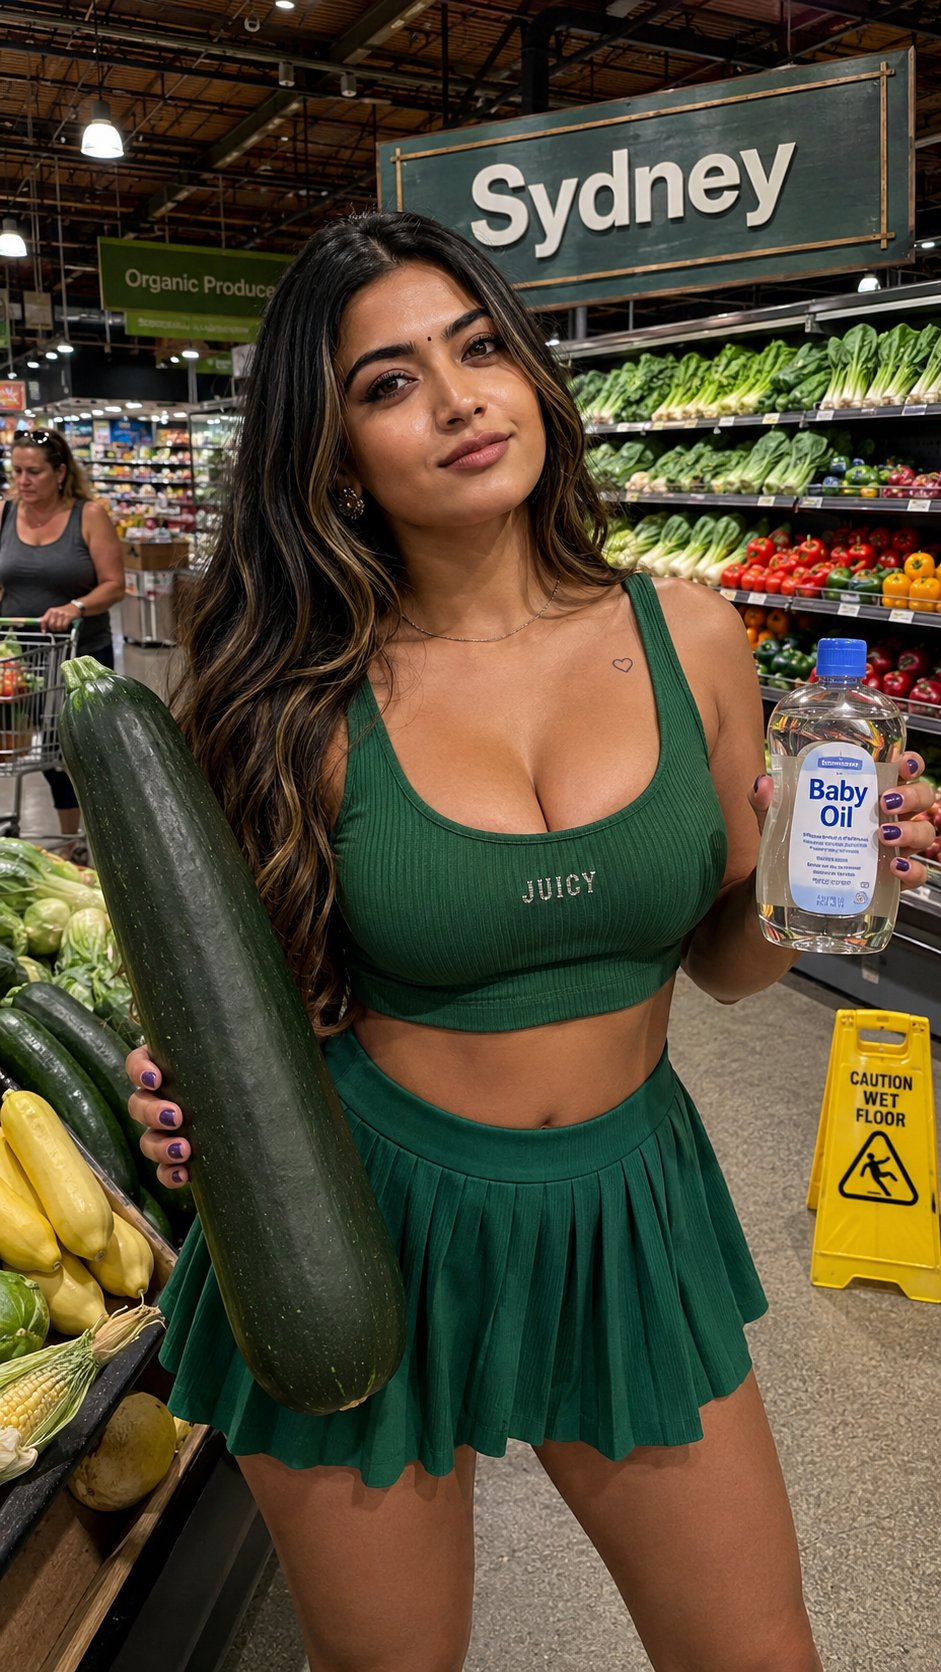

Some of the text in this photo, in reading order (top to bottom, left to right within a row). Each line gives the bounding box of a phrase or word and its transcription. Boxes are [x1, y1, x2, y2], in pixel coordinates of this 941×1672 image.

[470, 142, 797, 259] Sydney
[125, 268, 276, 299] Organic Produce
[809, 778, 868, 808] Baby
[820, 805, 853, 828] Oil
[521, 871, 596, 904] JUICY
[850, 1071, 913, 1091] CAUTION
[863, 1090, 899, 1108] WET
[856, 1108, 905, 1127] FLOOR
